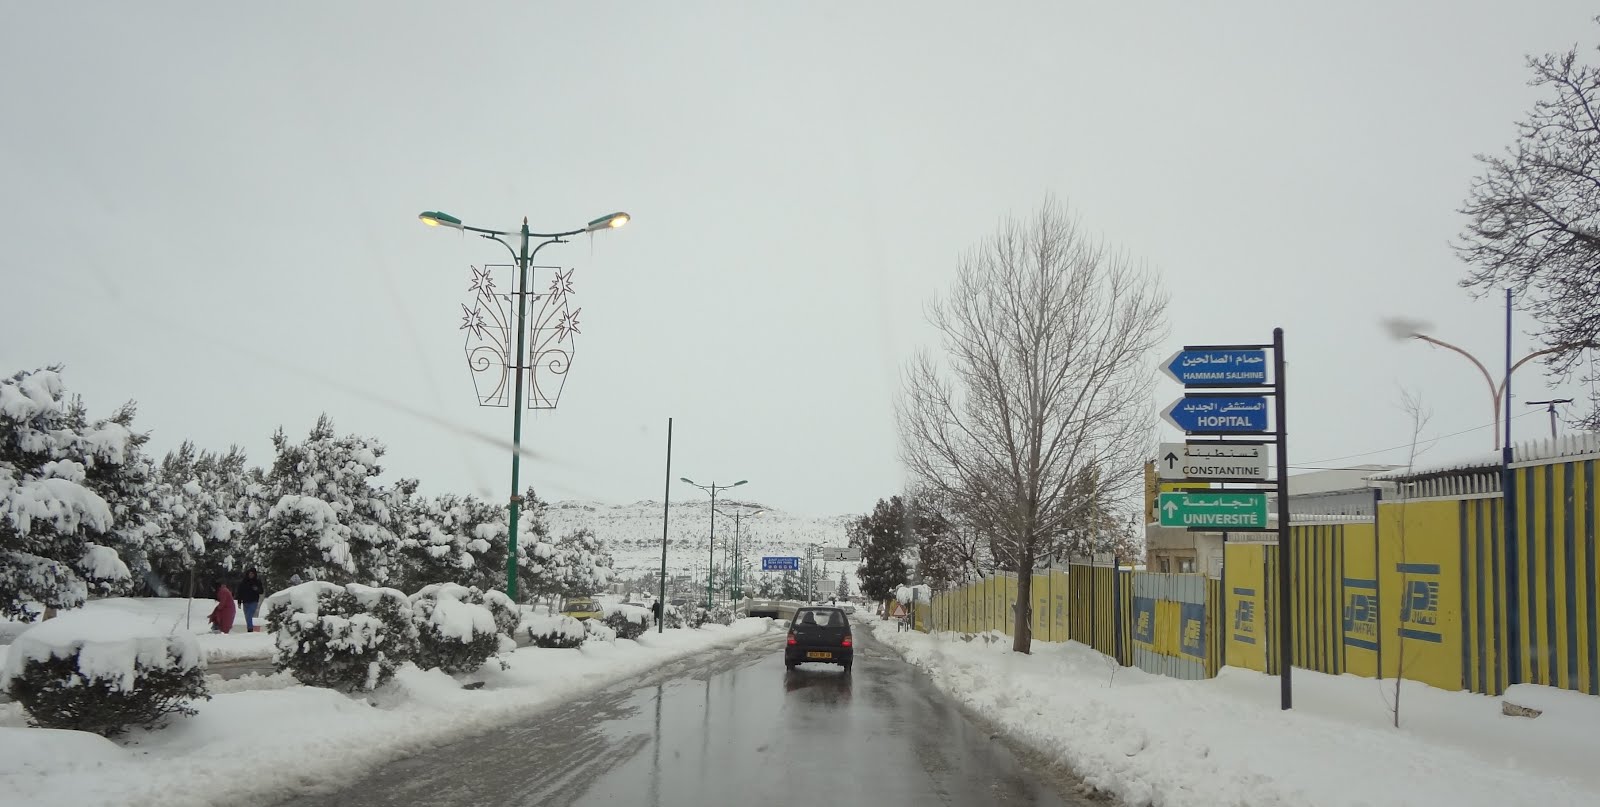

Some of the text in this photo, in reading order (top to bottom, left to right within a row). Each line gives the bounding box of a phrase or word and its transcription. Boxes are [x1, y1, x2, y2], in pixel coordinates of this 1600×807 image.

[1182, 354, 1263, 367] حمام الصالحين
[1183, 402, 1265, 413] المستشفى الجديد
[1197, 416, 1252, 427] HOPITAL
[1182, 466, 1260, 476] CONSTANTINE
[1182, 496, 1258, 509] الجامعة
[1183, 512, 1258, 525] UNIVERSITÉ
[1353, 622, 1376, 637] NAFTAL
